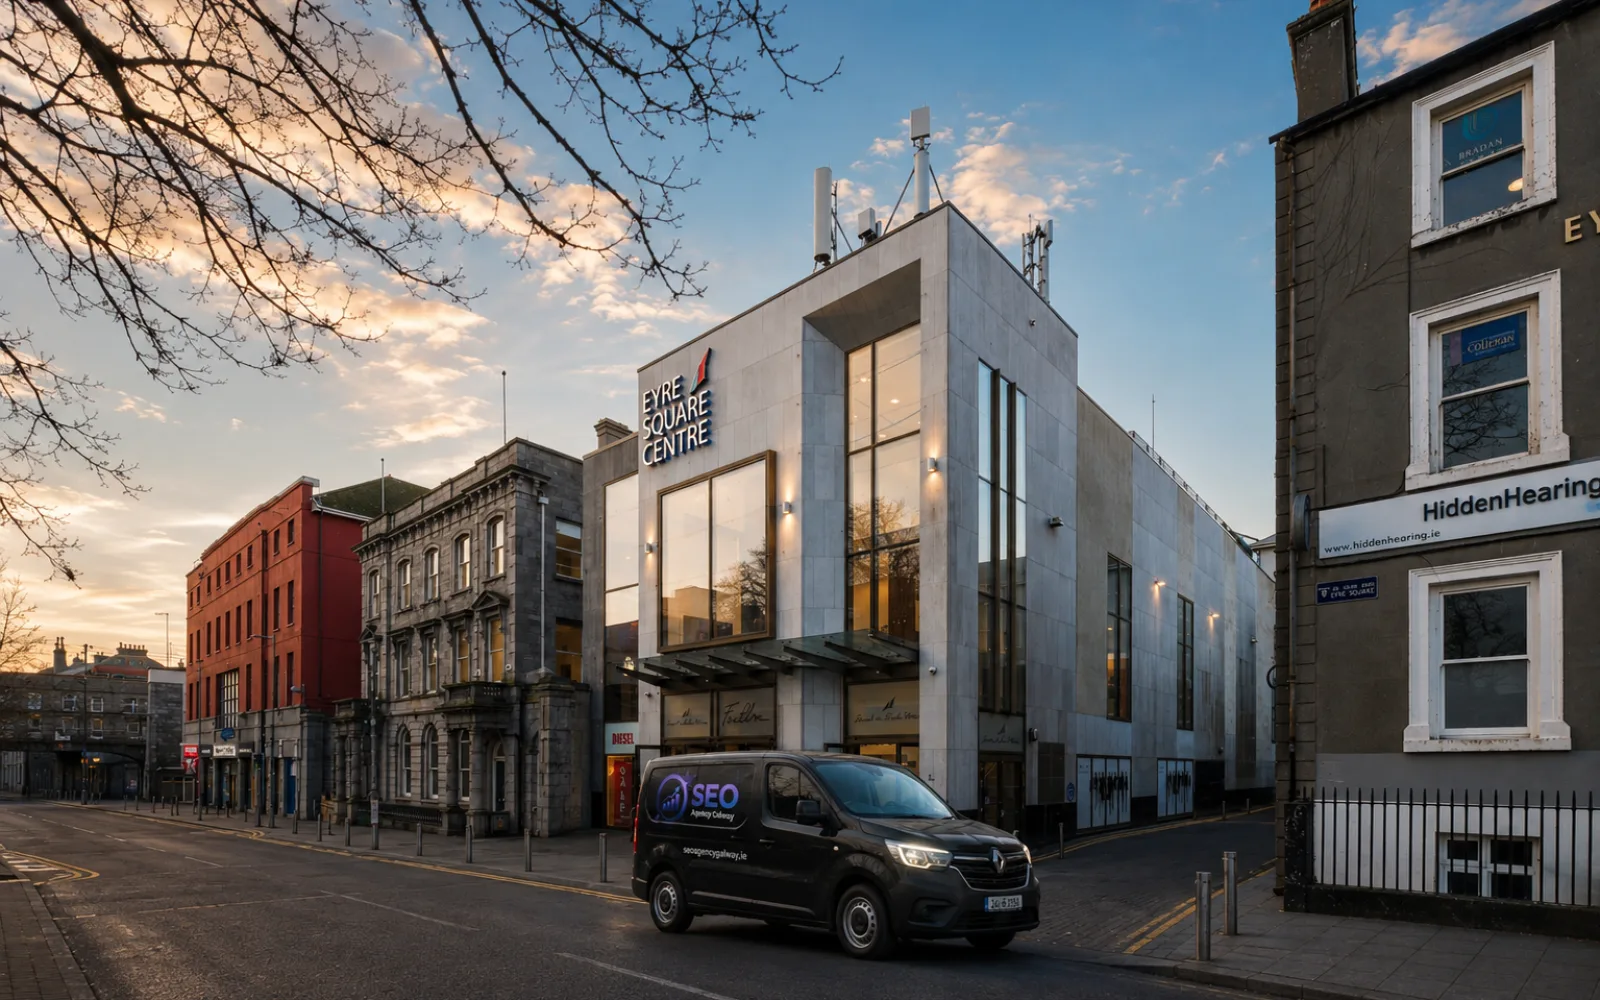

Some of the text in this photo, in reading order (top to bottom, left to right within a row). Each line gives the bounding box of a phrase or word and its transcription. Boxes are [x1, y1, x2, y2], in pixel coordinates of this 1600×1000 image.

[1458, 137, 1503, 161] BRADAN
[642, 375, 684, 415] EYRE
[642, 389, 711, 441] SQUARE
[642, 418, 711, 467] CENTRE
[1422, 476, 1600, 522] HiddenHearing
[1324, 529, 1441, 554] www.hiddenhearing.ie
[612, 732, 634, 745] DIESEL
[691, 783, 739, 809] SEO
